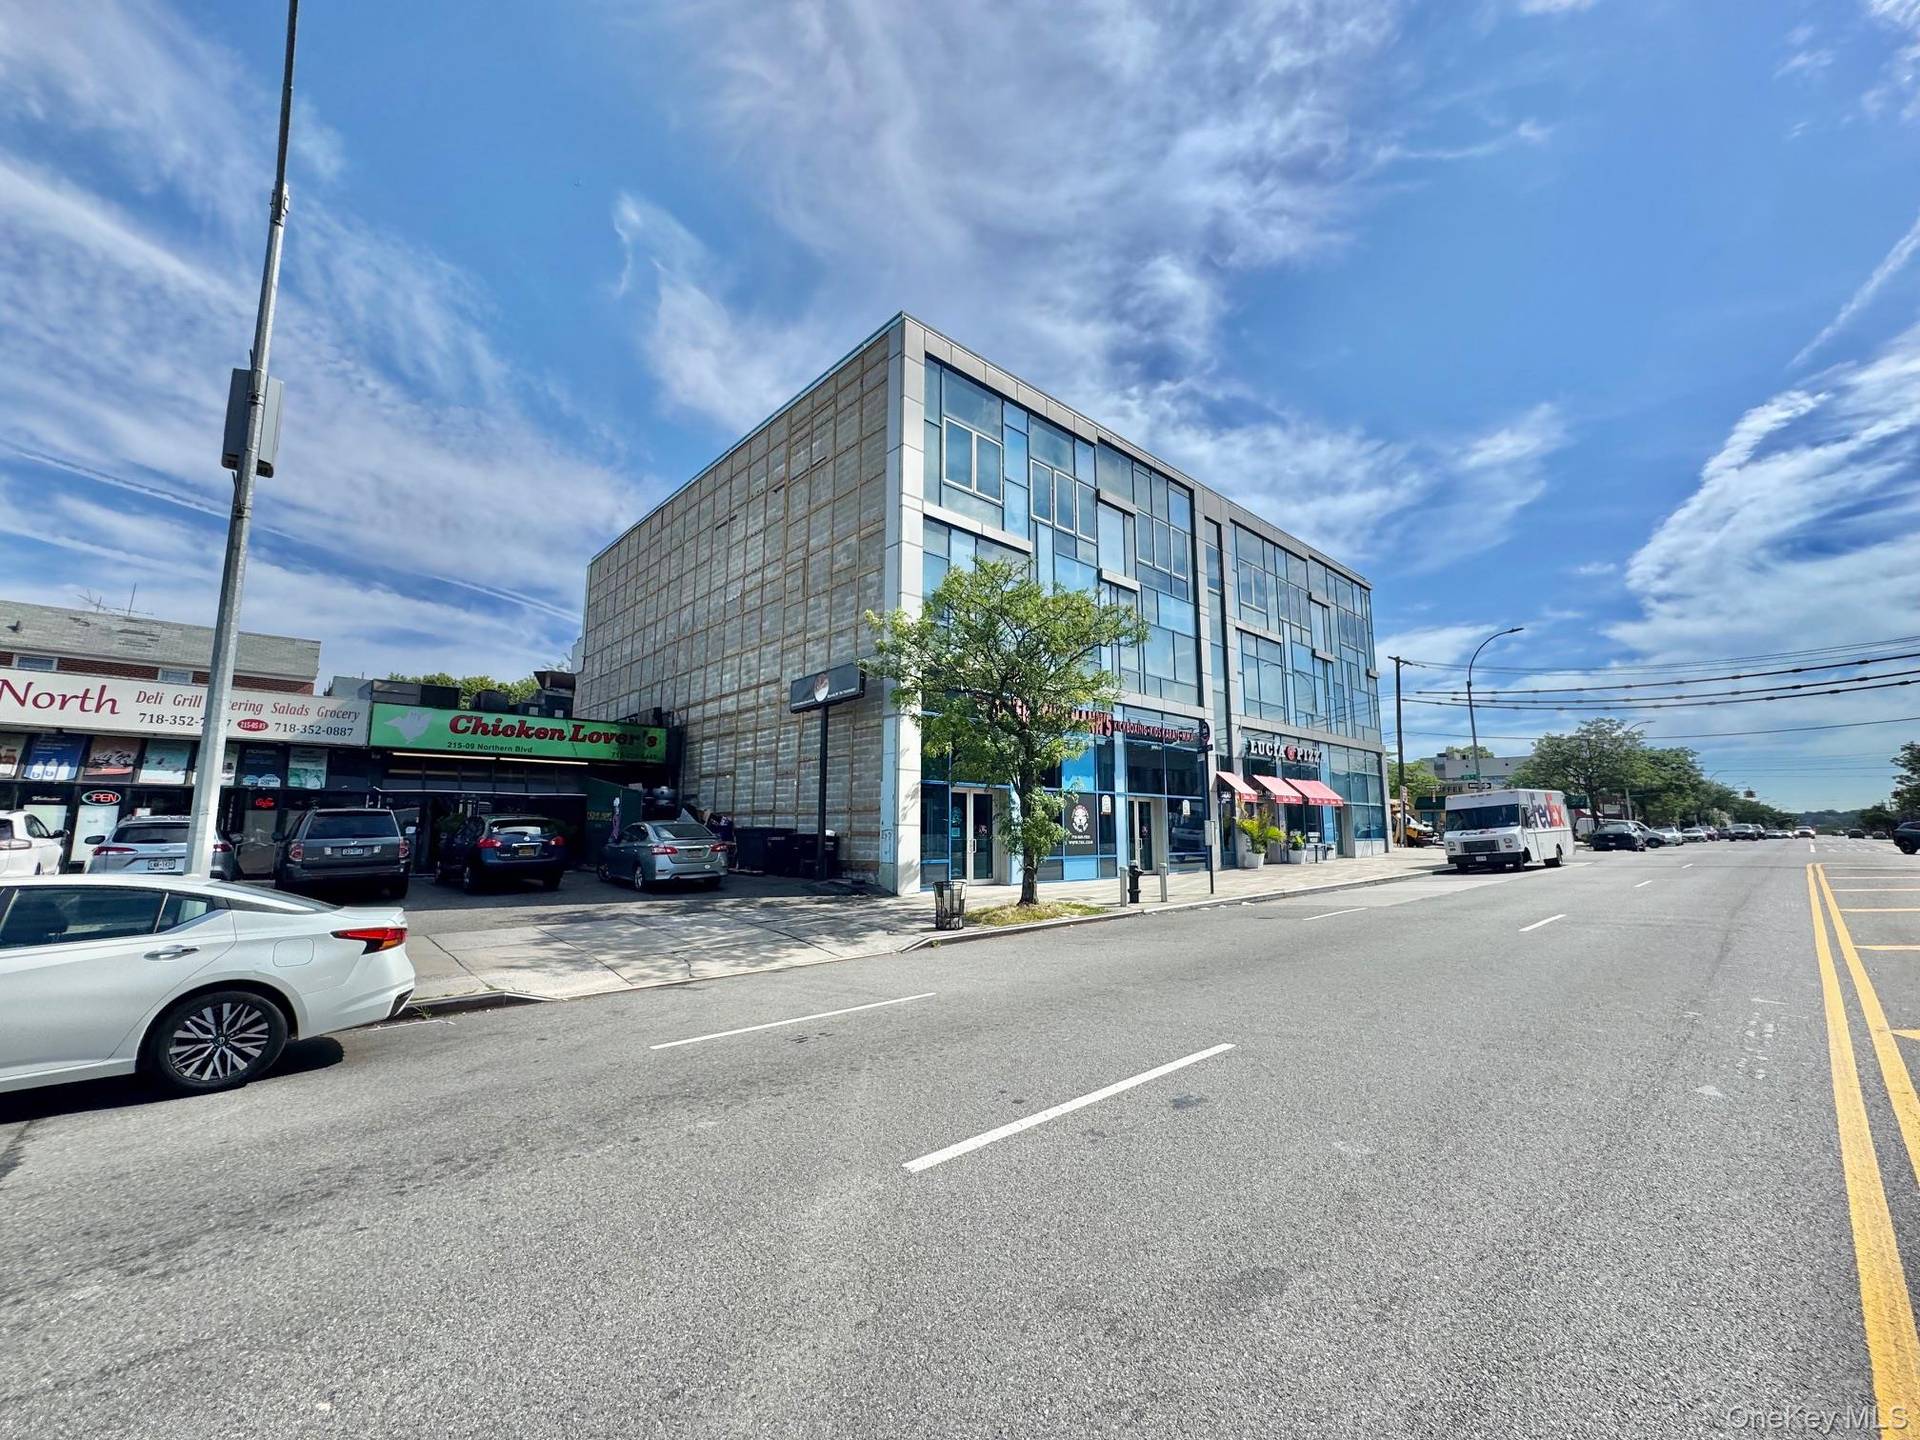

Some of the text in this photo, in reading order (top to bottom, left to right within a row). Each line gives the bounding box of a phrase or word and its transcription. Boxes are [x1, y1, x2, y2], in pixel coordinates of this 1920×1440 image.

[0, 678, 120, 715] North
[136, 690, 165, 706] Deli
[173, 693, 203, 708] Grill
[271, 702, 310, 717] Salads
[317, 706, 360, 721] Grocery
[274, 722, 353, 737] 718-352-0887
[449, 714, 658, 748] Chicken Lover's
[477, 742, 512, 753] Northern
[514, 744, 534, 754] Blvd
[1250, 740, 1286, 758] LUCIA
[86, 792, 117, 803] OPEN
